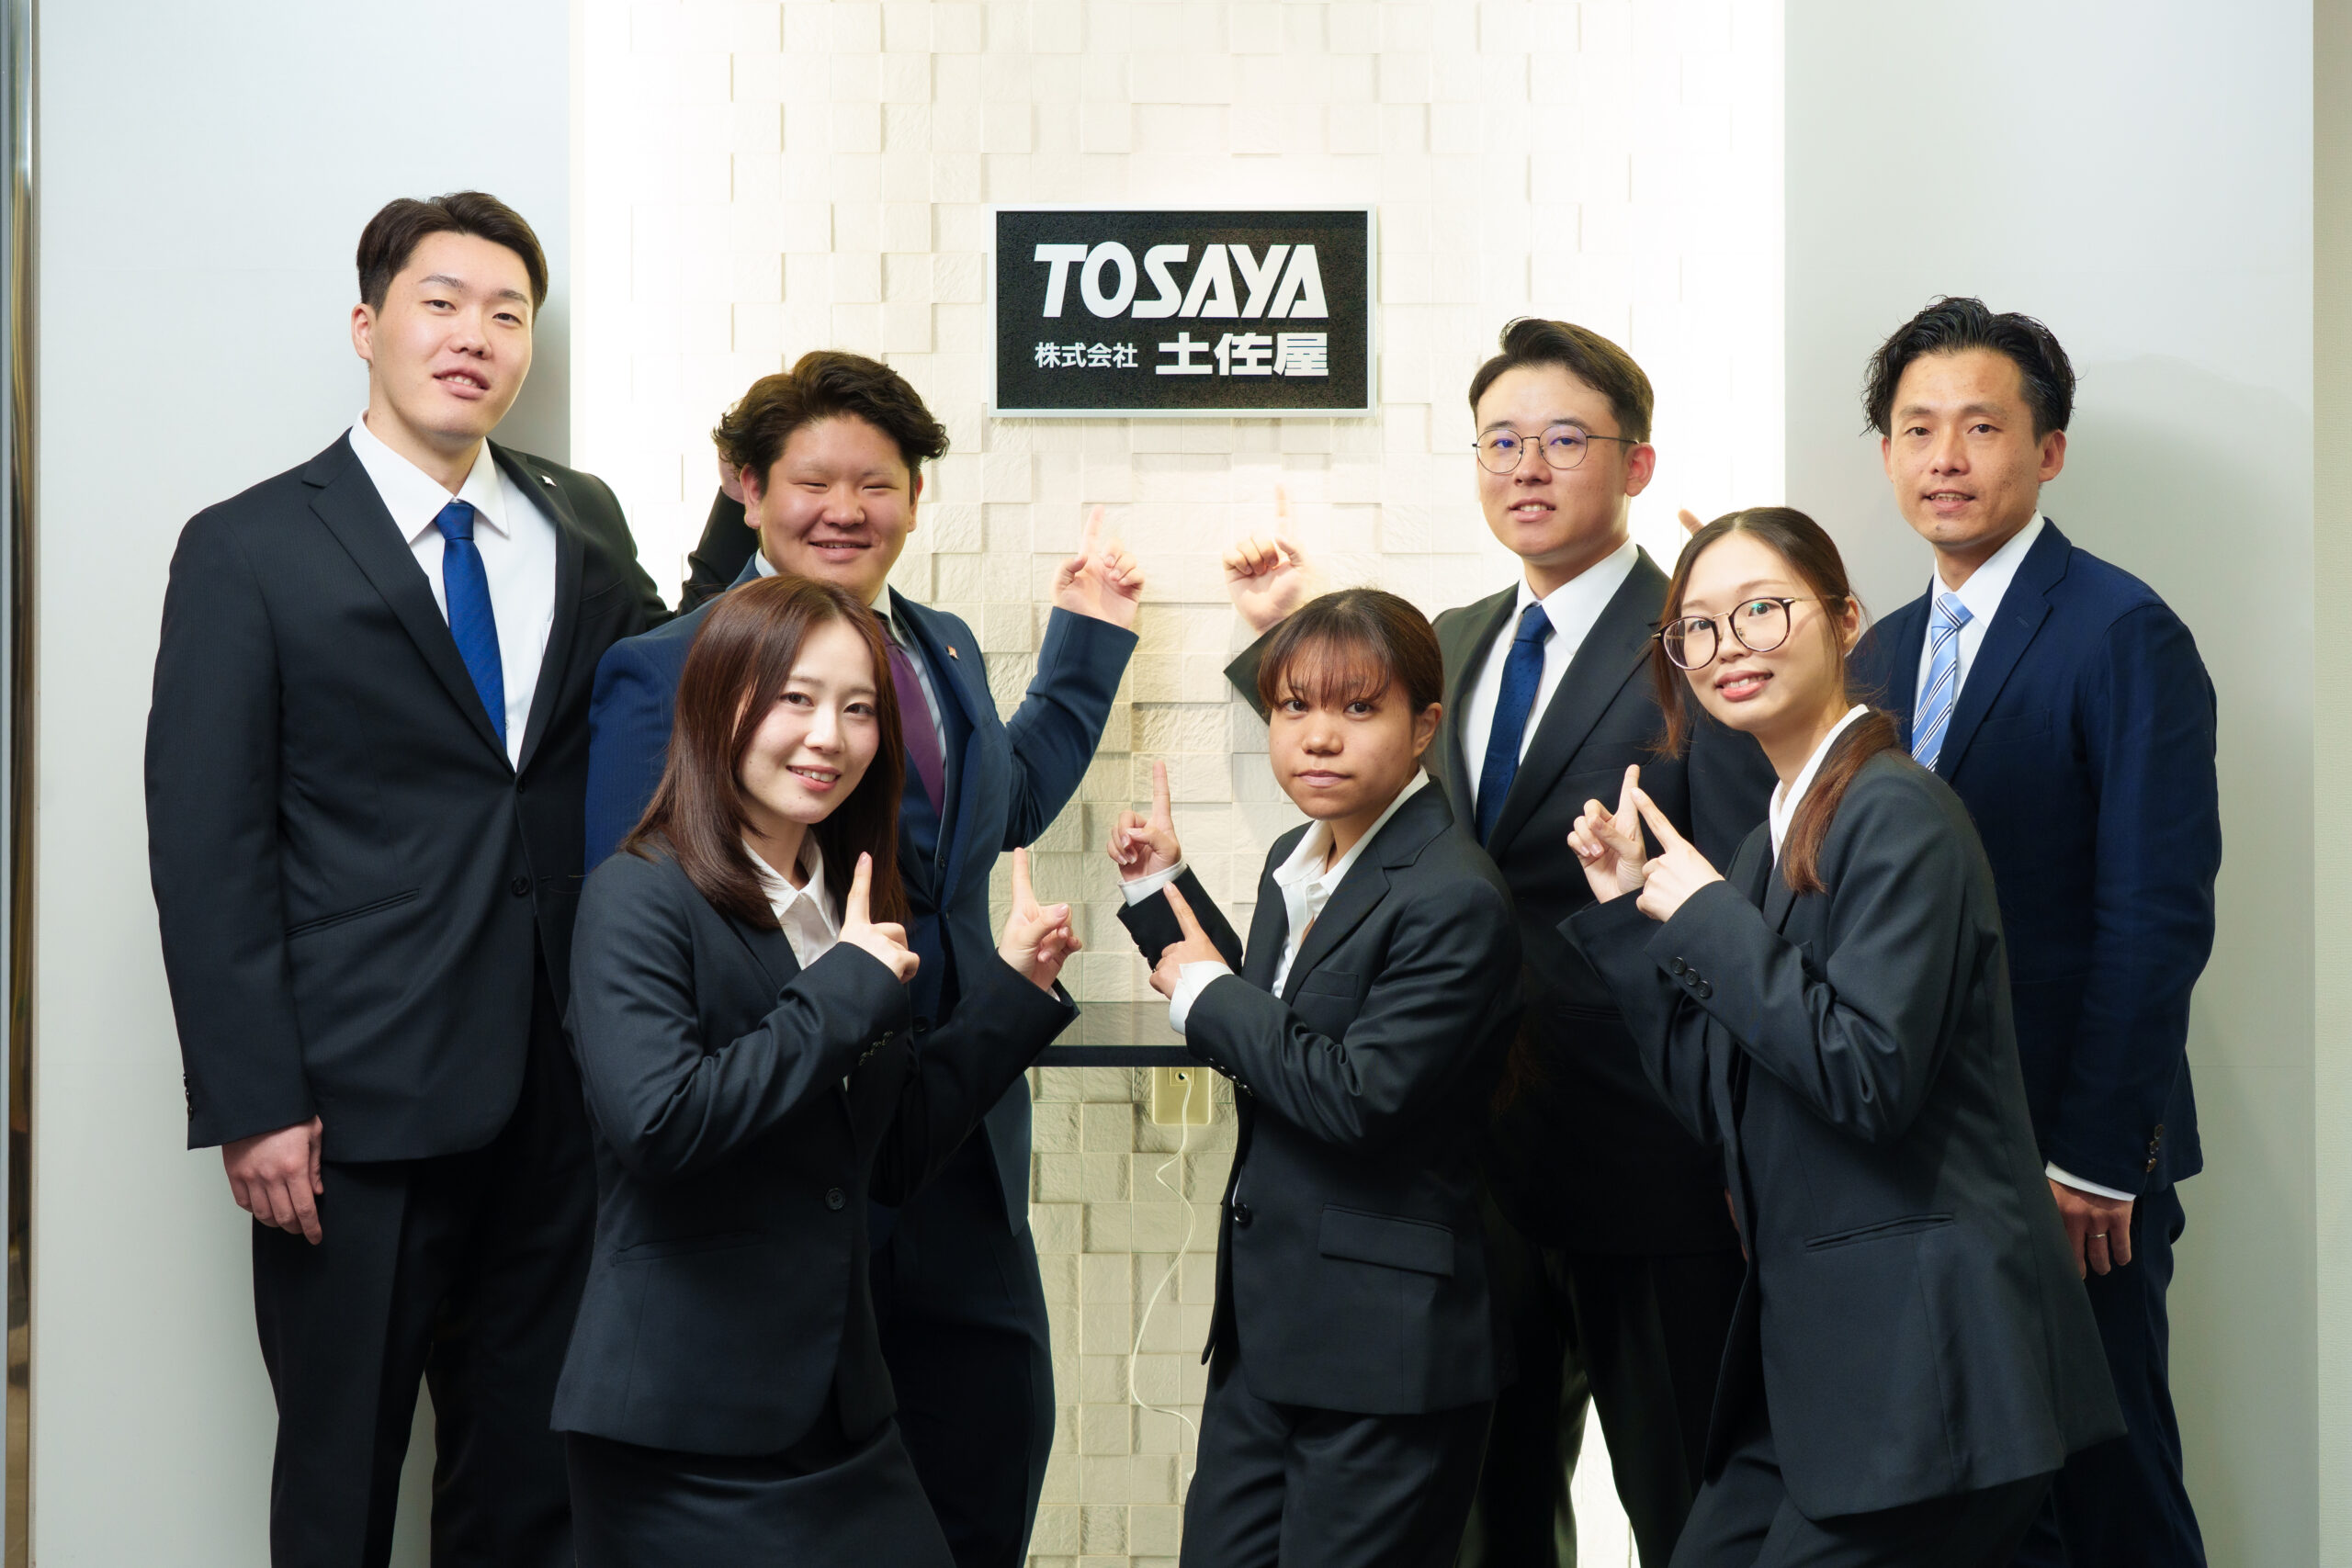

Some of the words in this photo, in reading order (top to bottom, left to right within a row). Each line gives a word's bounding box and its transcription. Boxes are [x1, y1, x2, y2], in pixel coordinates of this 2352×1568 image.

[1034, 241, 1329, 319] TOSAYA
[1035, 342, 1139, 368] 株式会社
[1155, 332, 1329, 377] 土佐屋
